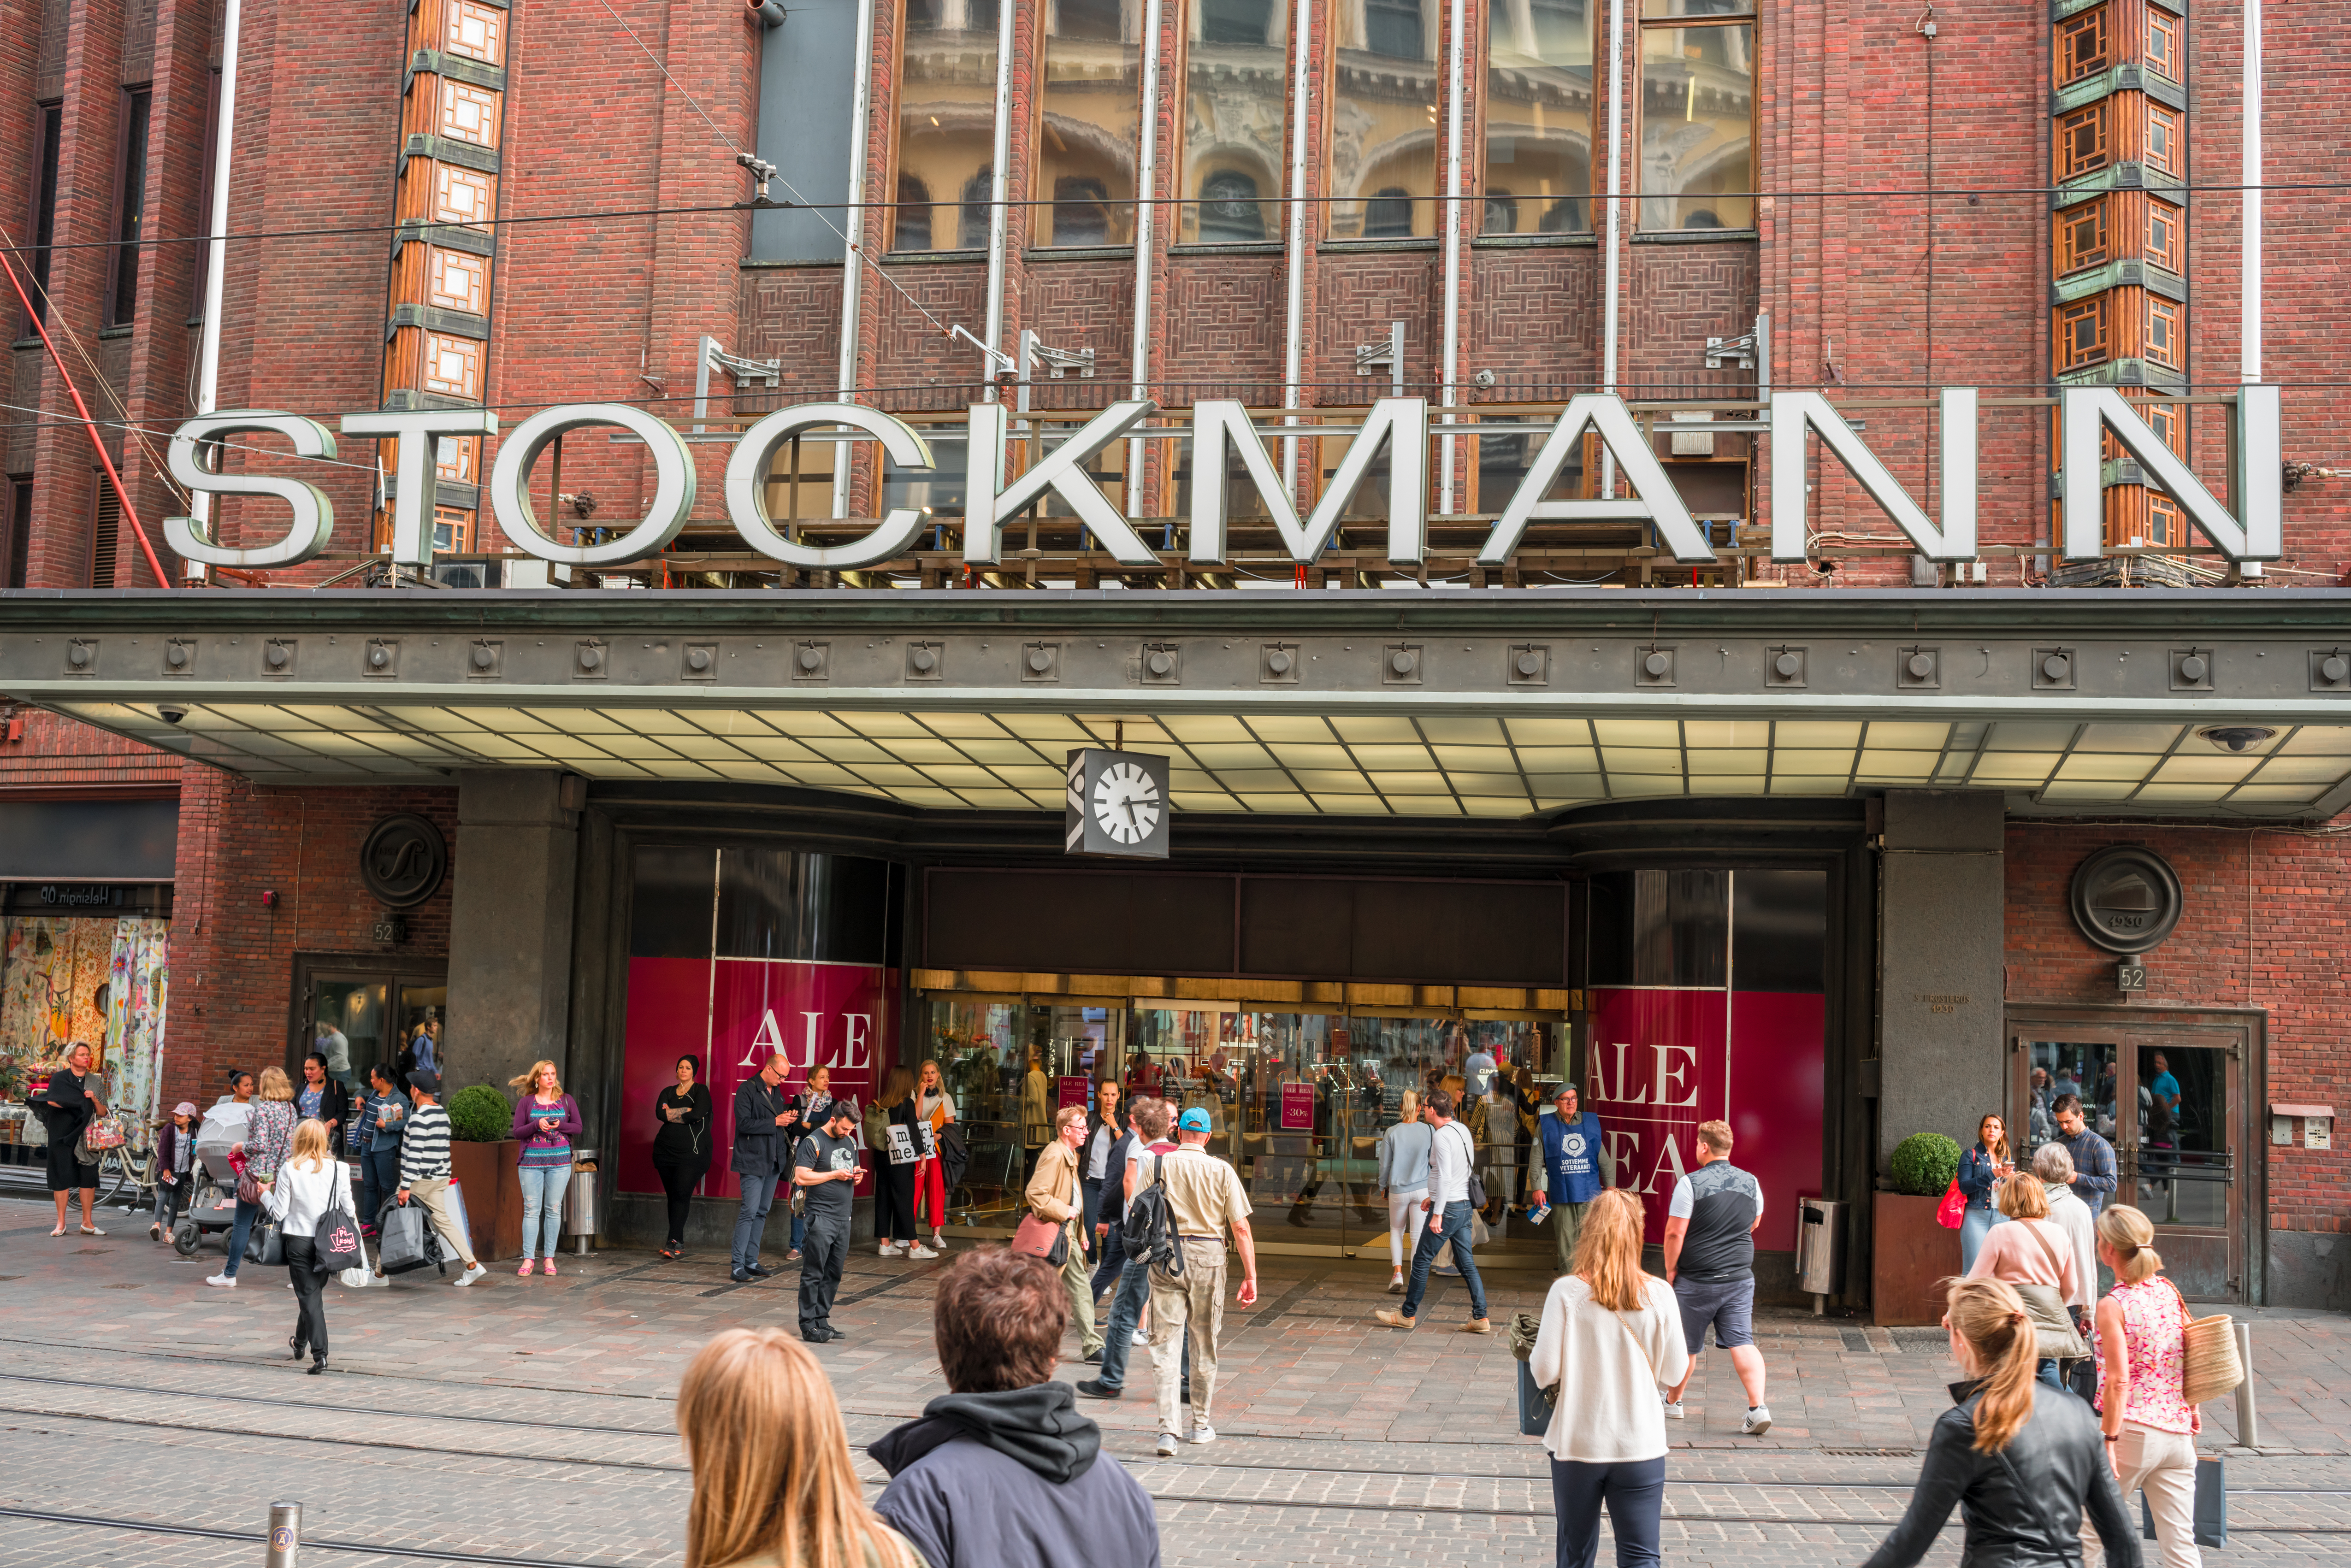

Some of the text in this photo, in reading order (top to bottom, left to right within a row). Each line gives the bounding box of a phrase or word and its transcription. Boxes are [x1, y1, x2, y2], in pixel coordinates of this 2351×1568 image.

[163, 386, 2282, 570] STOCKMANN
[2109, 915, 2144, 927] 1930
[376, 925, 392, 940] 52
[395, 925, 404, 940] 52
[2122, 969, 2143, 986] 52
[1924, 995, 1971, 1003] FROSTERUS
[1932, 1005, 1955, 1013] 1930
[738, 1009, 871, 1068] ALE
[1587, 1041, 1697, 1107] ALE
[1287, 1108, 1308, 1117] -30%
[896, 1124, 933, 1142] mri
[1600, 1130, 1686, 1194] EA
